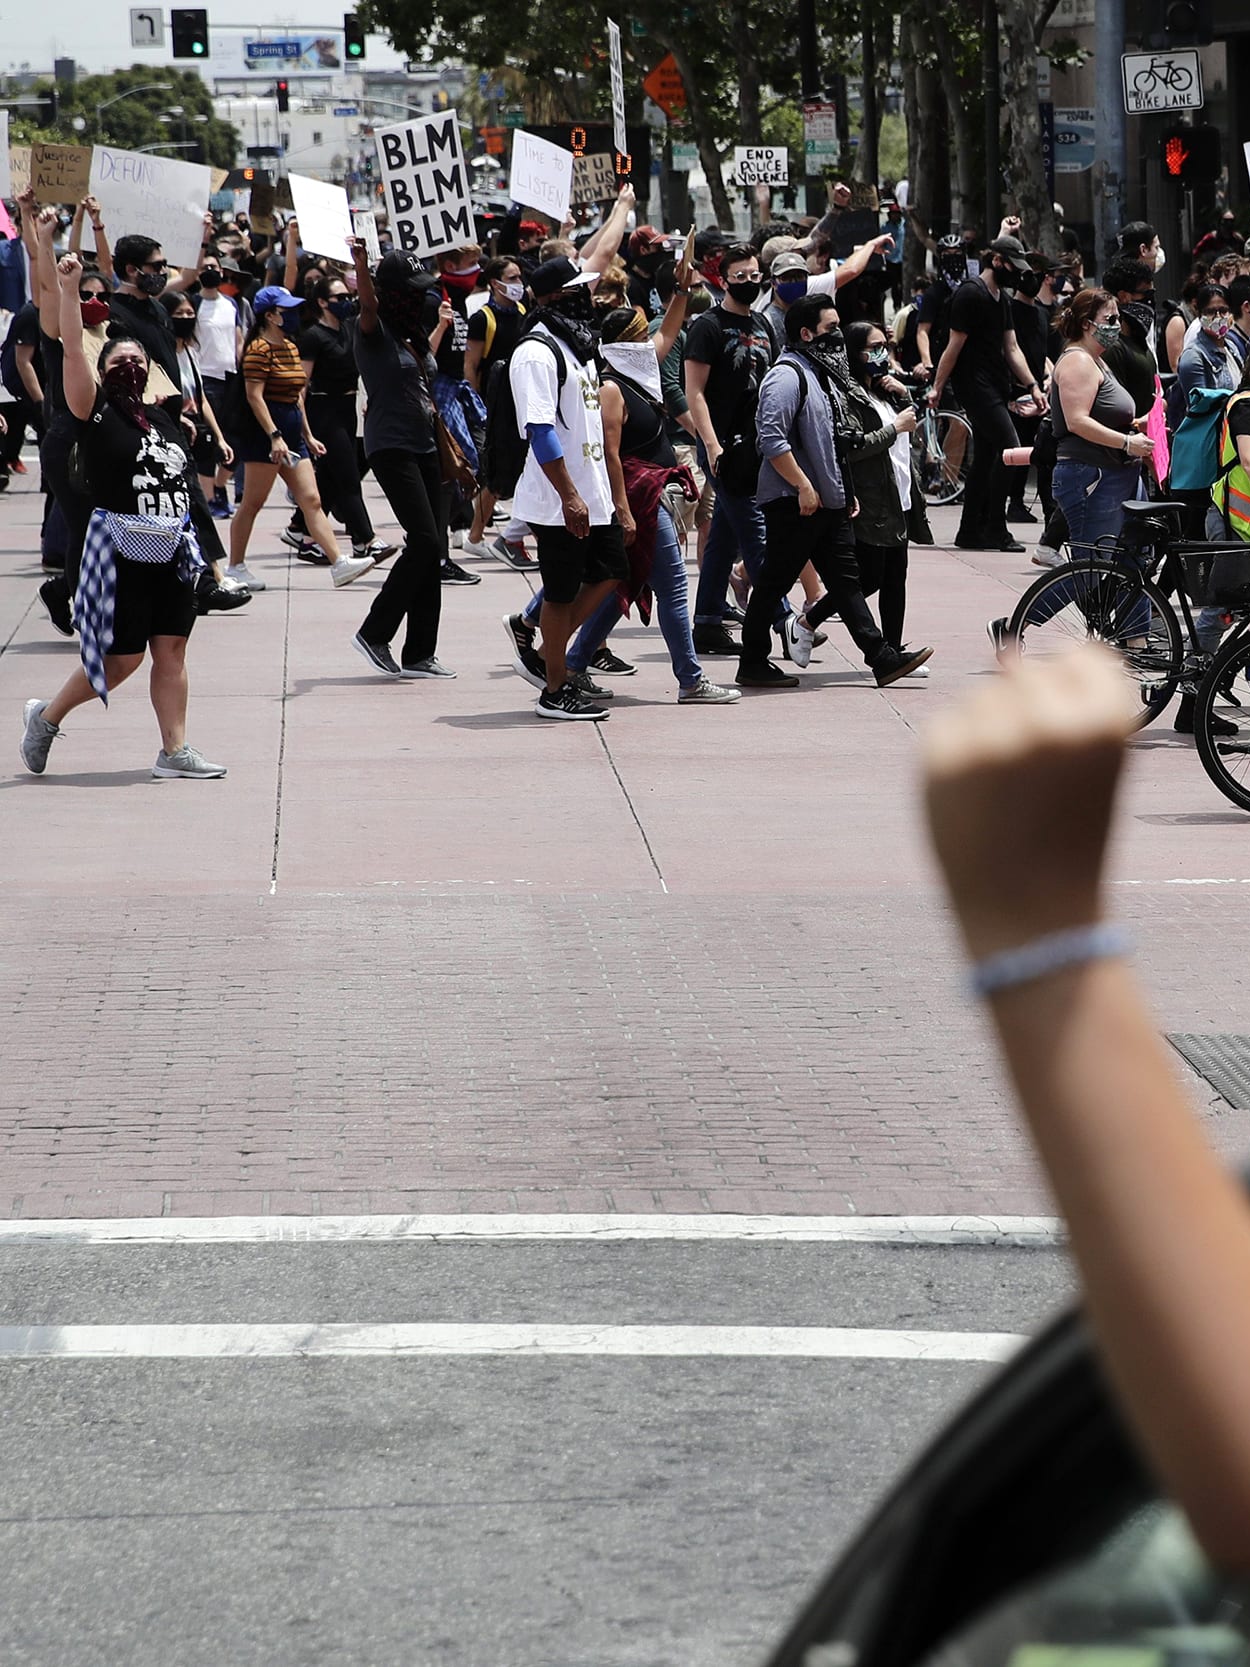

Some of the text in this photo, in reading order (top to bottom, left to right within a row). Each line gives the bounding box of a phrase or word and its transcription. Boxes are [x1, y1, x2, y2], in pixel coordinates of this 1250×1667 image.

[252, 45, 297, 56] Spring St
[1135, 96, 1160, 109] BIKE
[1165, 93, 1192, 107] LANE
[381, 118, 458, 171] BLM
[35, 144, 82, 164] Justice
[746, 149, 774, 160] END
[592, 157, 604, 170] U
[740, 160, 781, 174] POLICE
[37, 173, 65, 188] ALL
[594, 170, 614, 184] US
[738, 172, 788, 184] VIOLENCE
[390, 164, 465, 214] BLM
[516, 169, 564, 209] LISTEN
[396, 205, 471, 251] BLM
